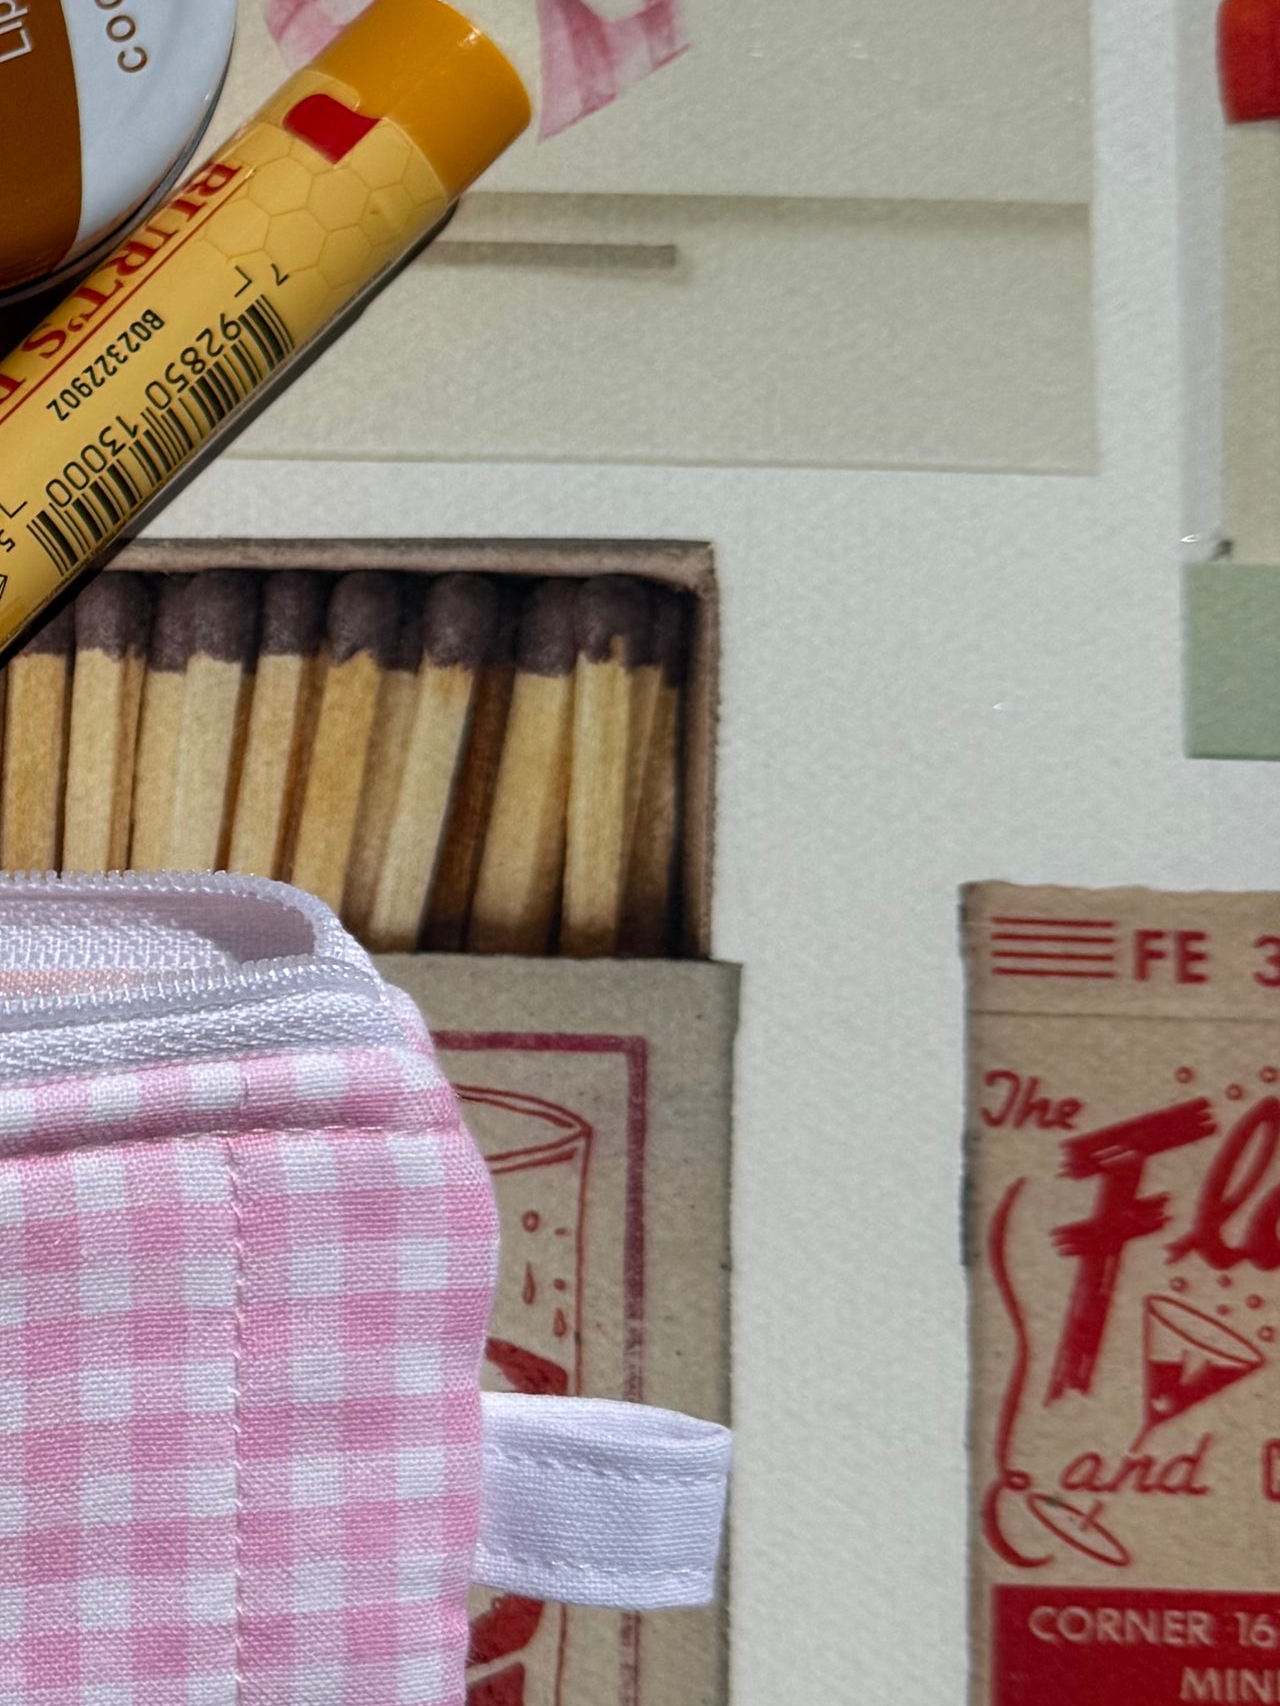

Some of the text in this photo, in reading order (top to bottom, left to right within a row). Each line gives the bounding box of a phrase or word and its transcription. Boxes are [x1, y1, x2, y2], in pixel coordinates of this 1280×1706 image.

[23, 162, 243, 361] BURT'S
[270, 262, 291, 287] 7
[144, 312, 243, 411] 92850
[45, 415, 140, 509] 13000
[1133, 927, 1209, 984] FE
[978, 1068, 1085, 1131] The
[1060, 1432, 1216, 1497] and
[1027, 1605, 1280, 1651] CORNER 16
[1180, 1666, 1280, 1706] MIN
